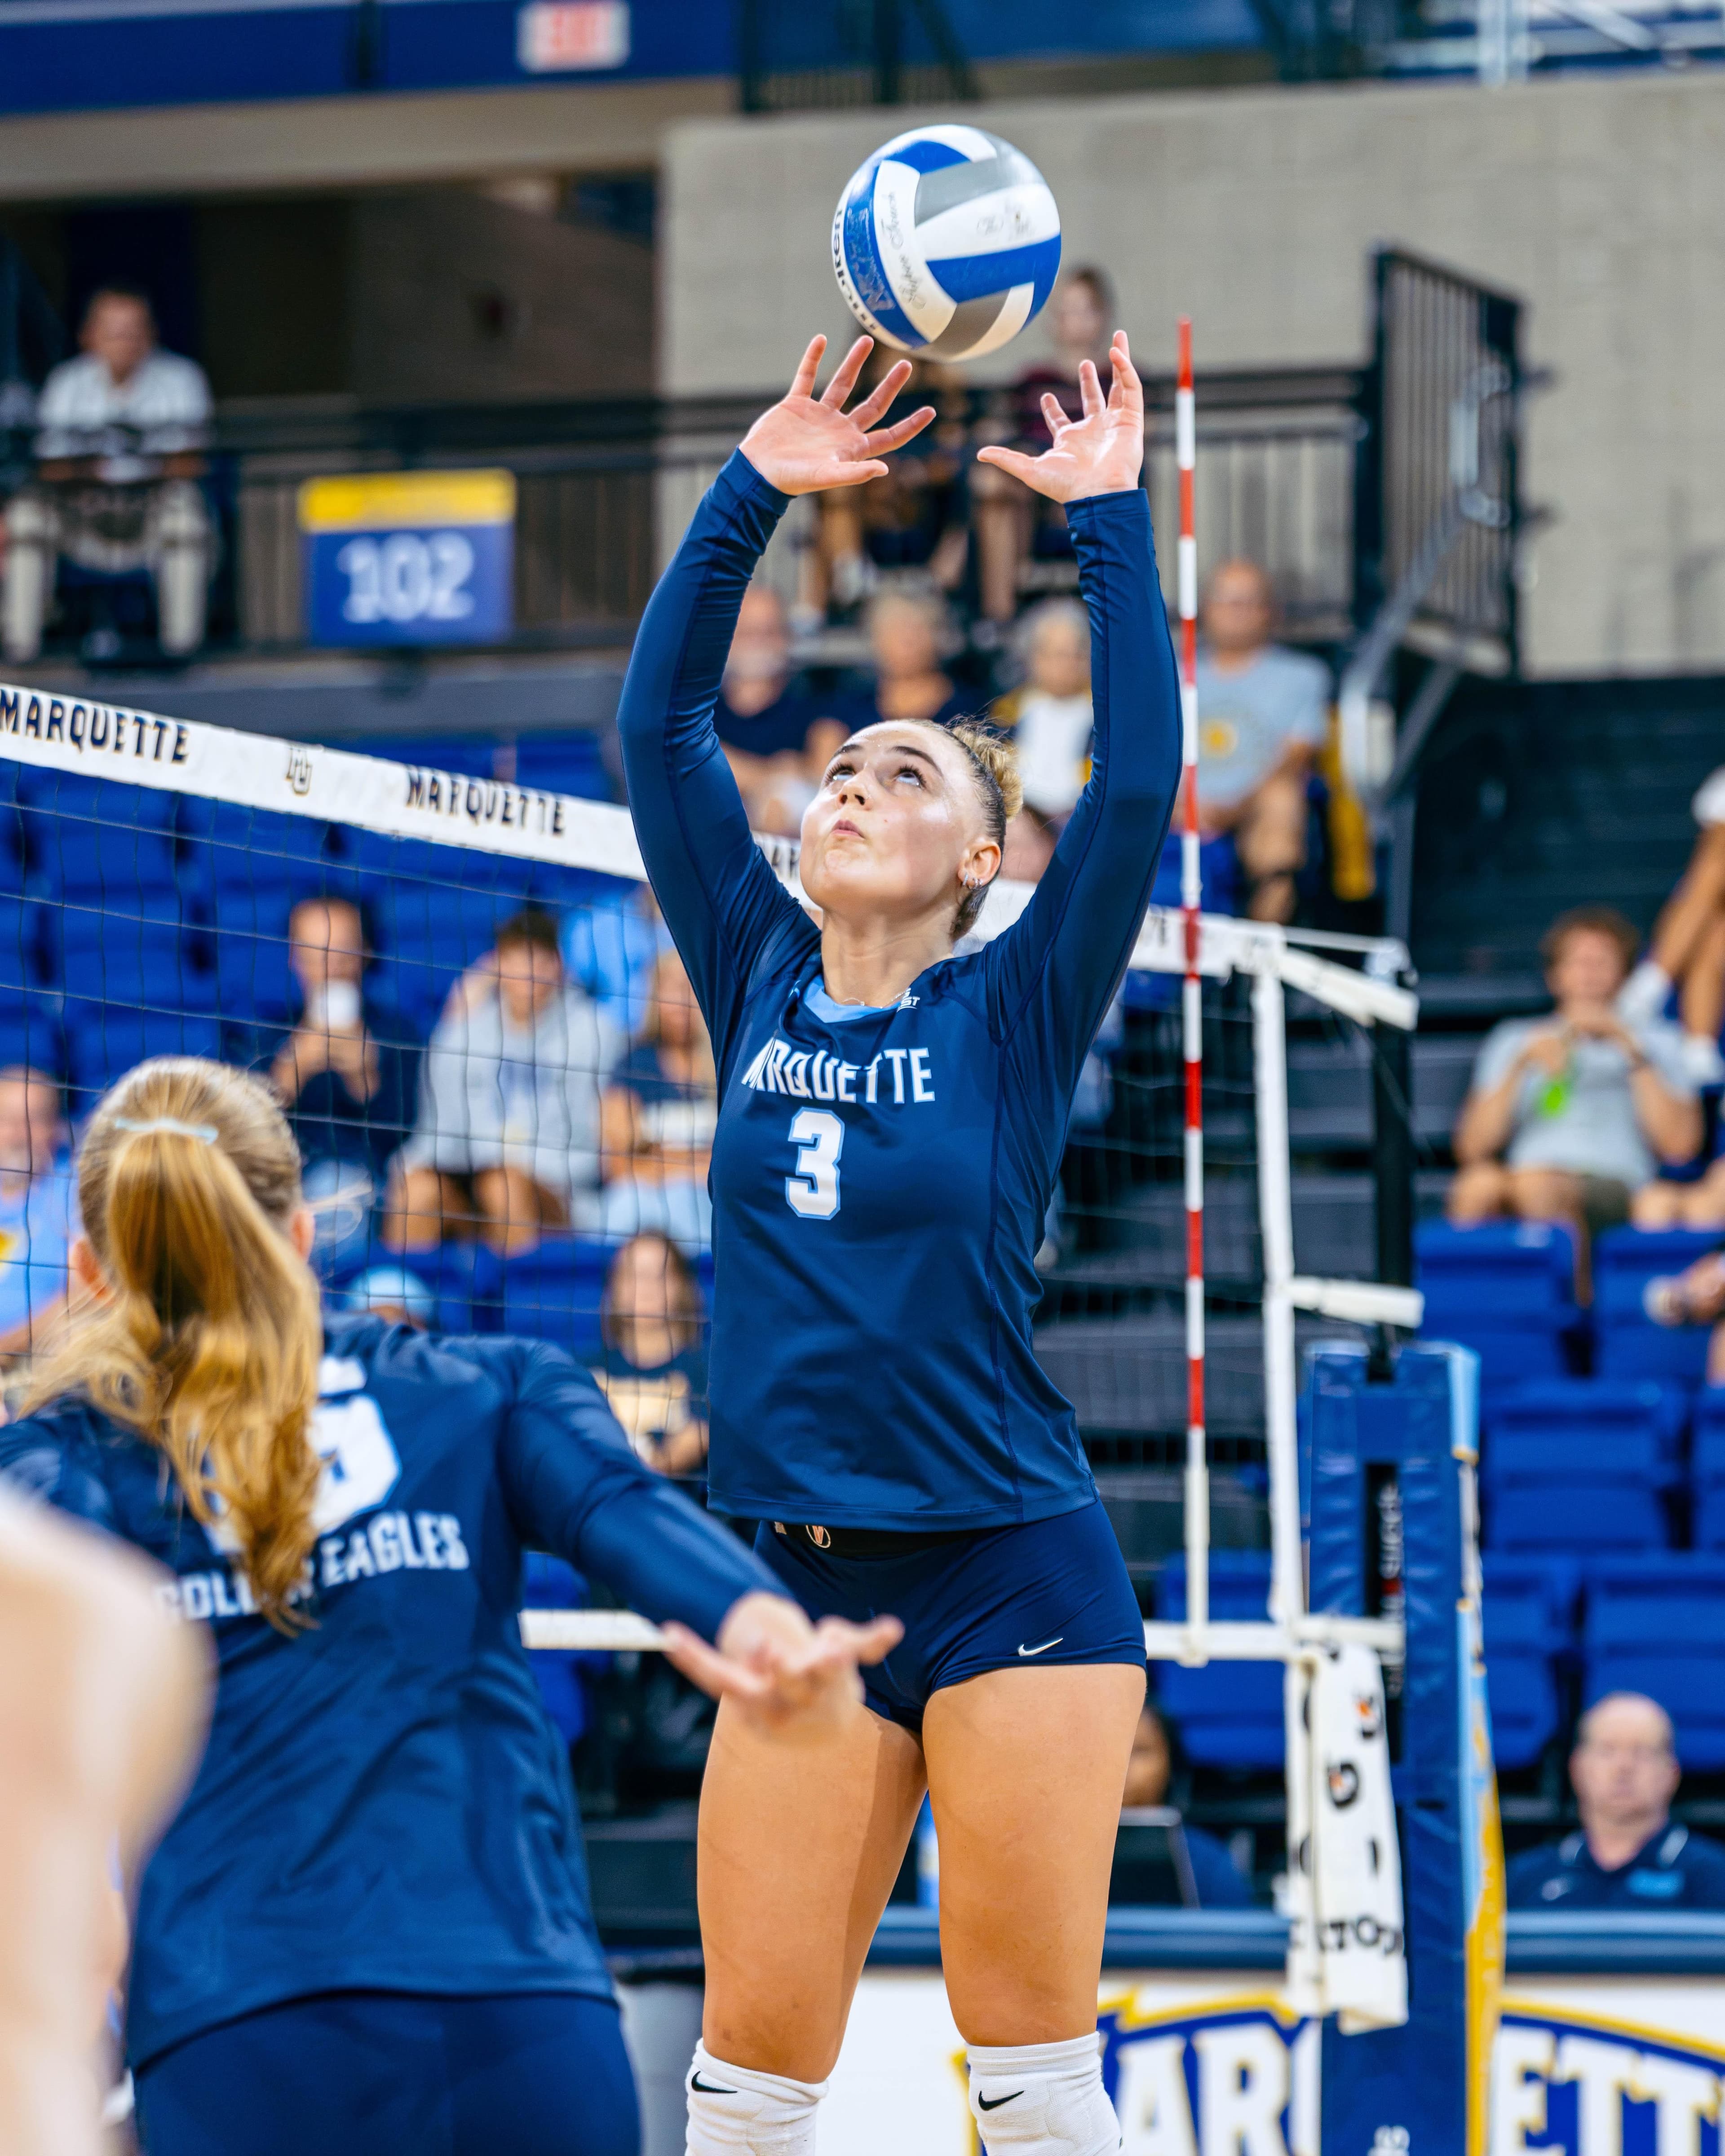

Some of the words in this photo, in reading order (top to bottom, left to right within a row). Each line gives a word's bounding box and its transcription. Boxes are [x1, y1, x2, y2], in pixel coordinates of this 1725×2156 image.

[336, 531, 475, 623] 102
[0, 689, 190, 764] MARQUETTE
[406, 766, 565, 836] MARQUETTE
[785, 1106, 845, 1220] 3
[320, 1509, 470, 1588] EAGLES
